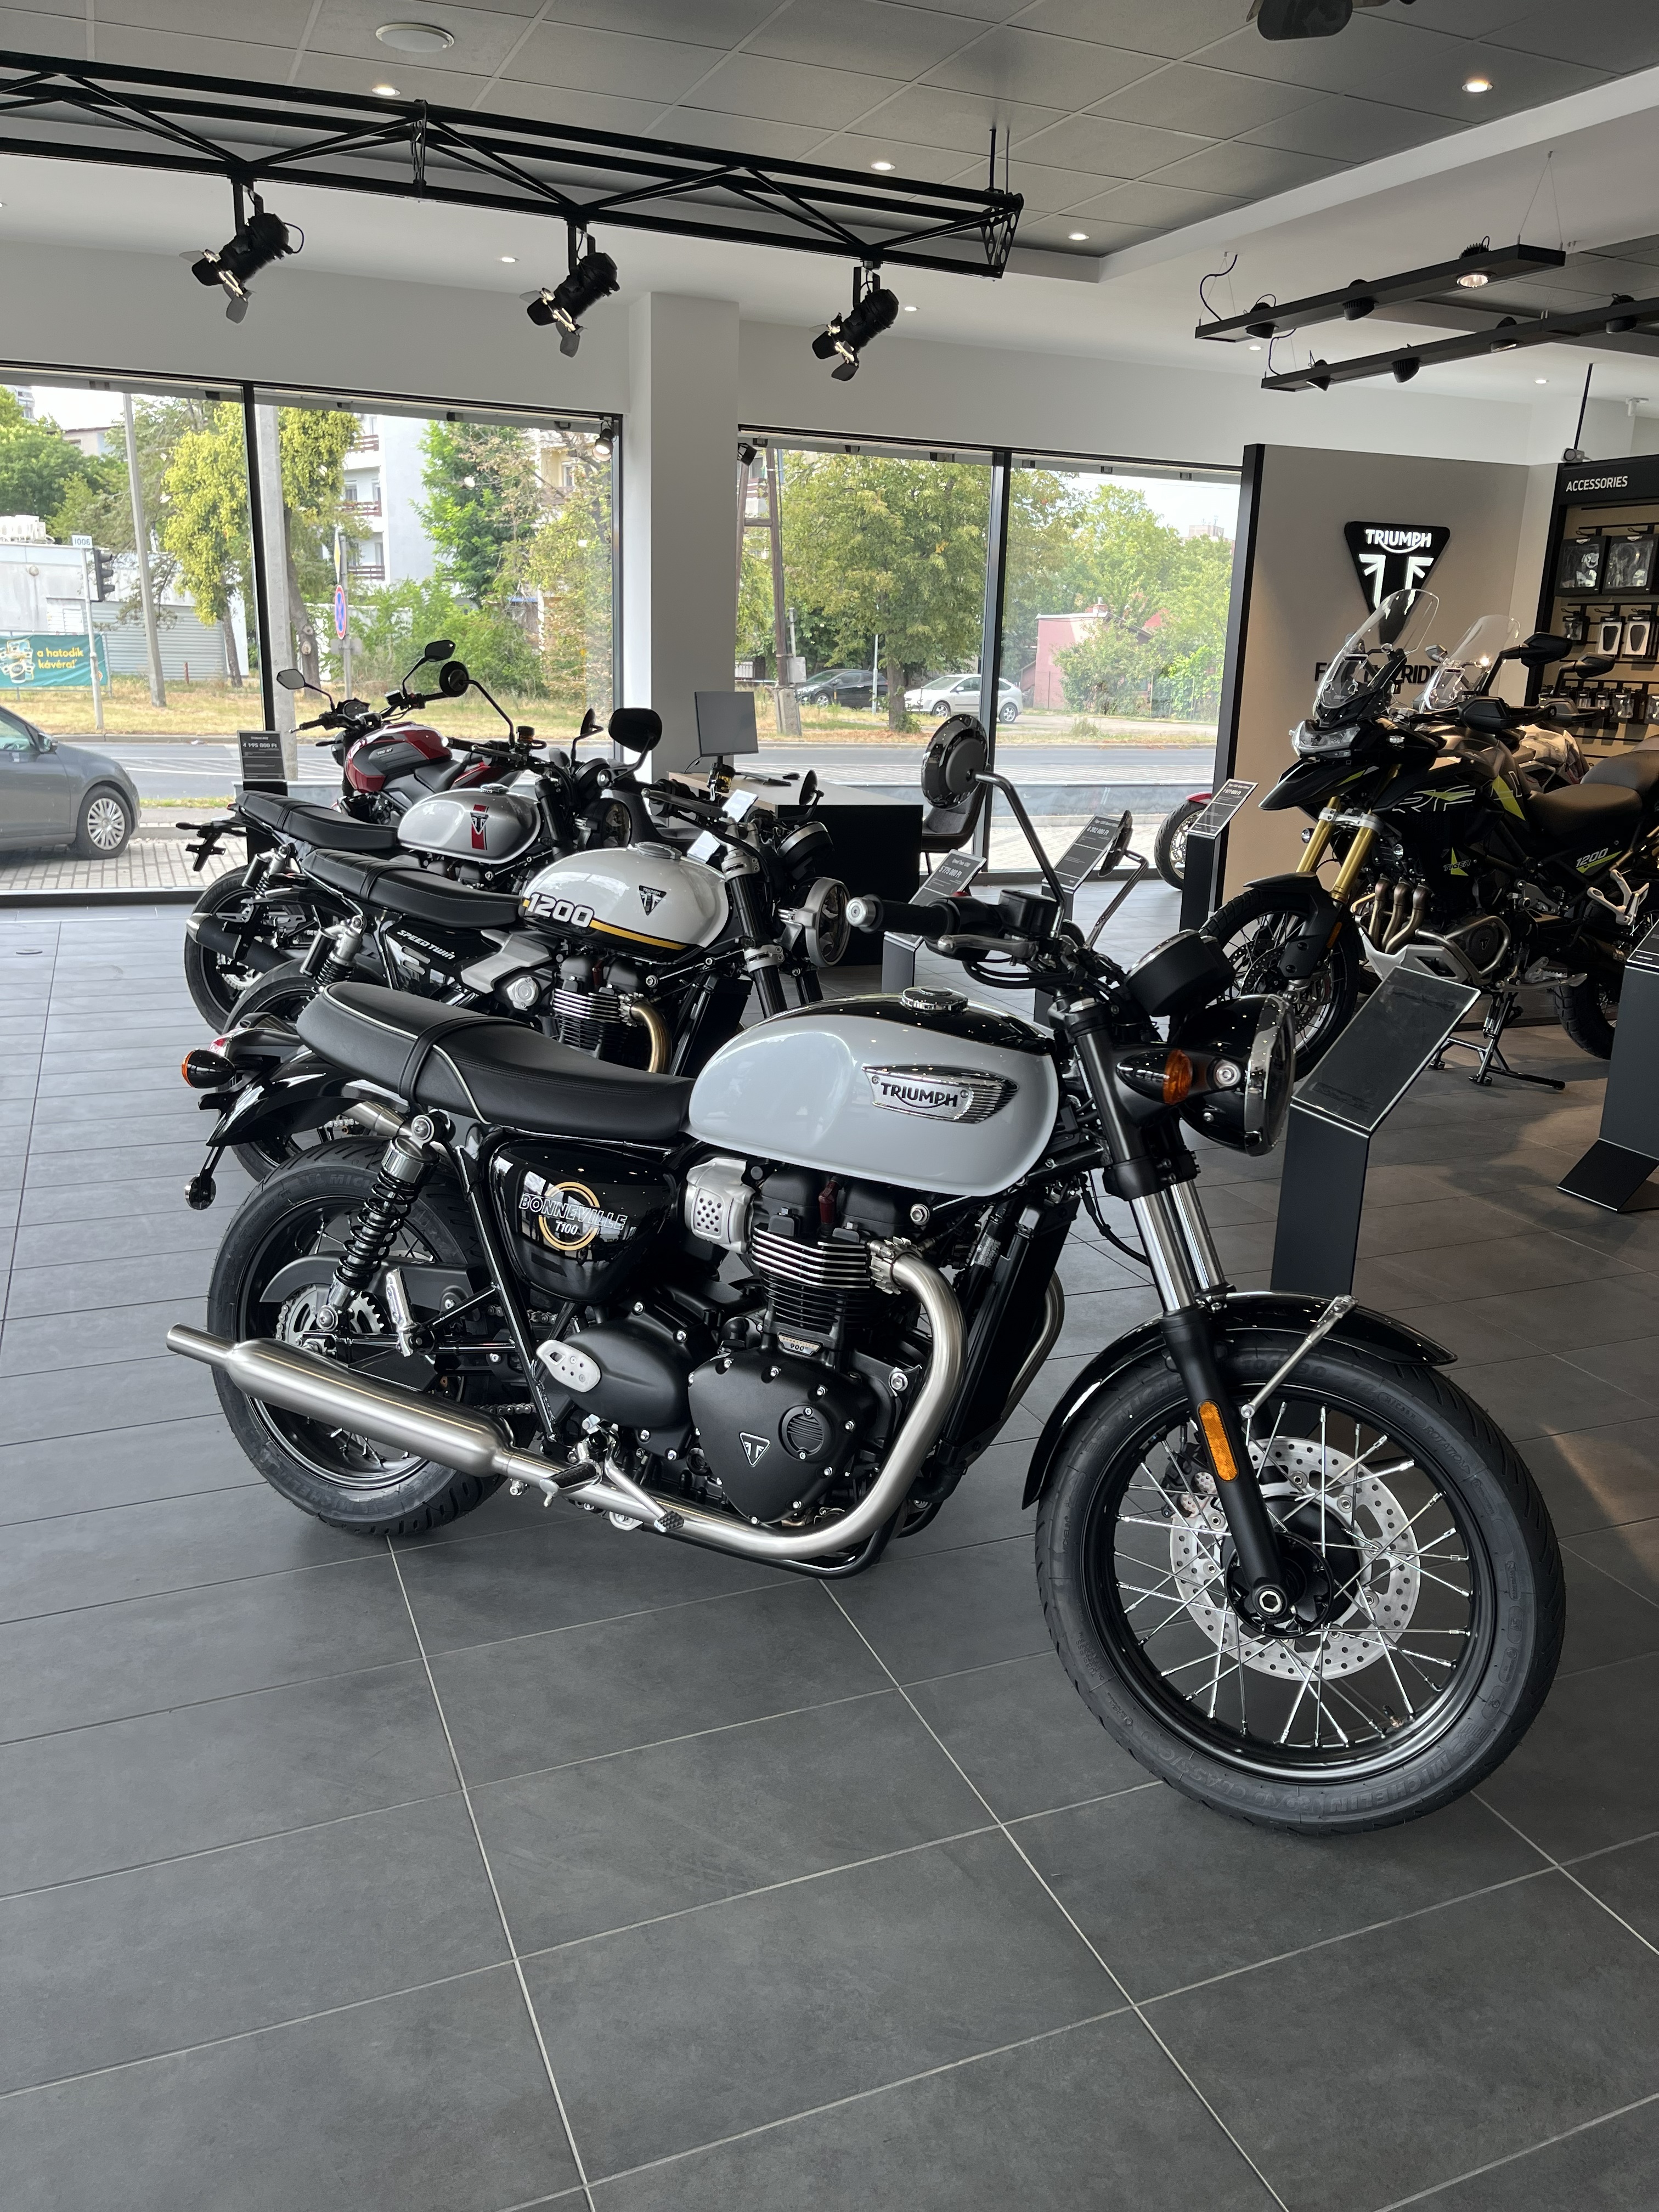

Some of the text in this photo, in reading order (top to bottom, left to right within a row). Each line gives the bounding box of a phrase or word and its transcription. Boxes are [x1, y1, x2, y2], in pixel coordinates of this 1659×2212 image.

[1565, 476, 1628, 492] ACCESSORIES
[1365, 529, 1432, 554] TRIUMPH
[46, 647, 84, 657] hatodik
[1443, 859, 1471, 872] TIGER
[1575, 848, 1609, 868] 1200
[528, 893, 594, 928] 1200
[397, 929, 430, 947] SPEED
[881, 1082, 958, 1109] TRIUMPH
[518, 1193, 628, 1231] BONNEVILLE
[555, 1220, 579, 1235] T100
[790, 1343, 804, 1351] 900
[1425, 1425, 1466, 1467] ROTATION
[1329, 1753, 1453, 1813] MICHELIN
